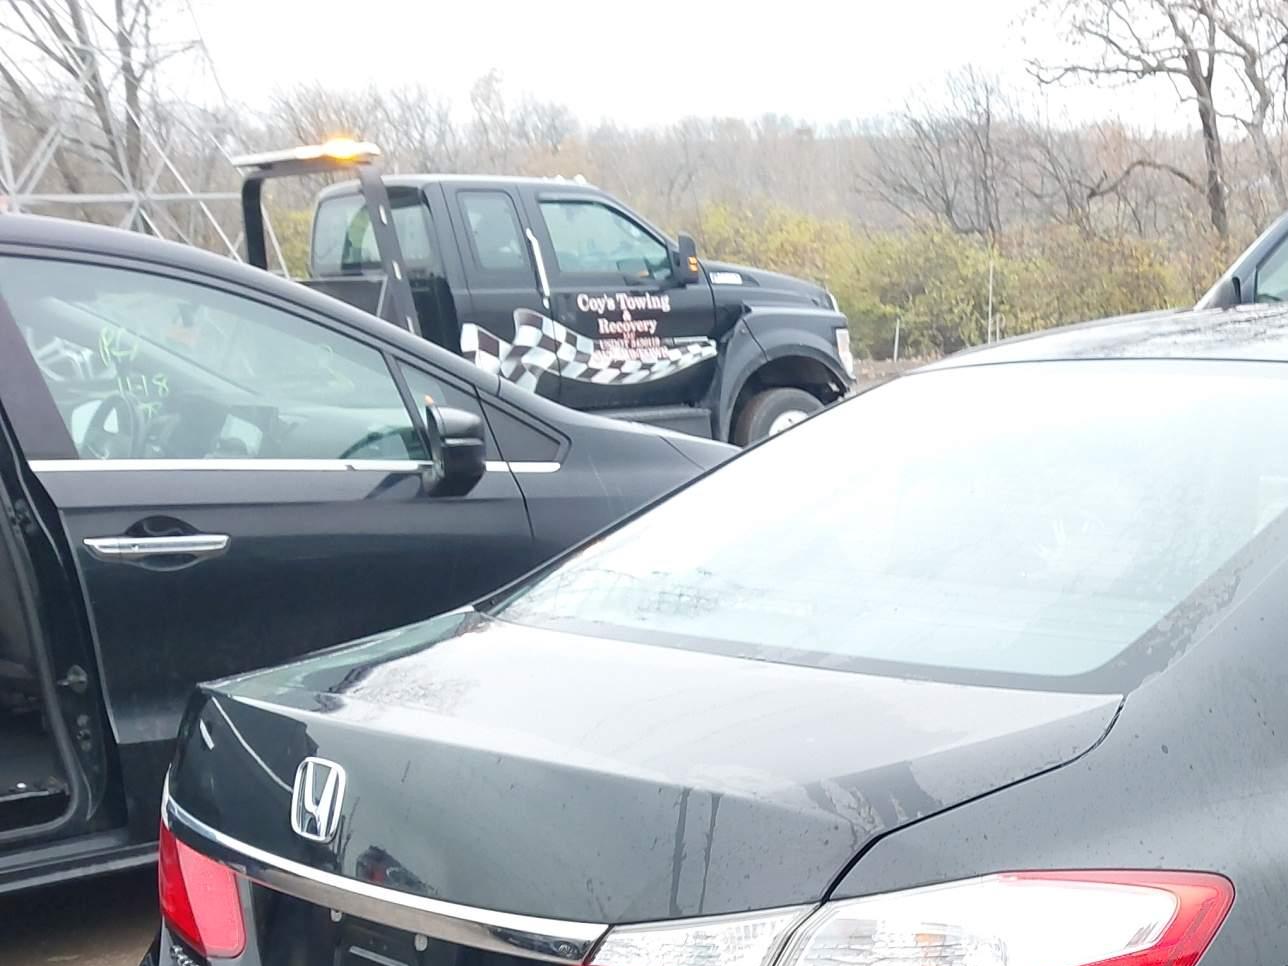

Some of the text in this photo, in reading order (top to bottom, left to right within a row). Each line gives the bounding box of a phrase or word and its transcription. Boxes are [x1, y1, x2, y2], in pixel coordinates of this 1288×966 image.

[577, 292, 671, 314] Coy's Towing
[598, 318, 657, 334] Recovery
